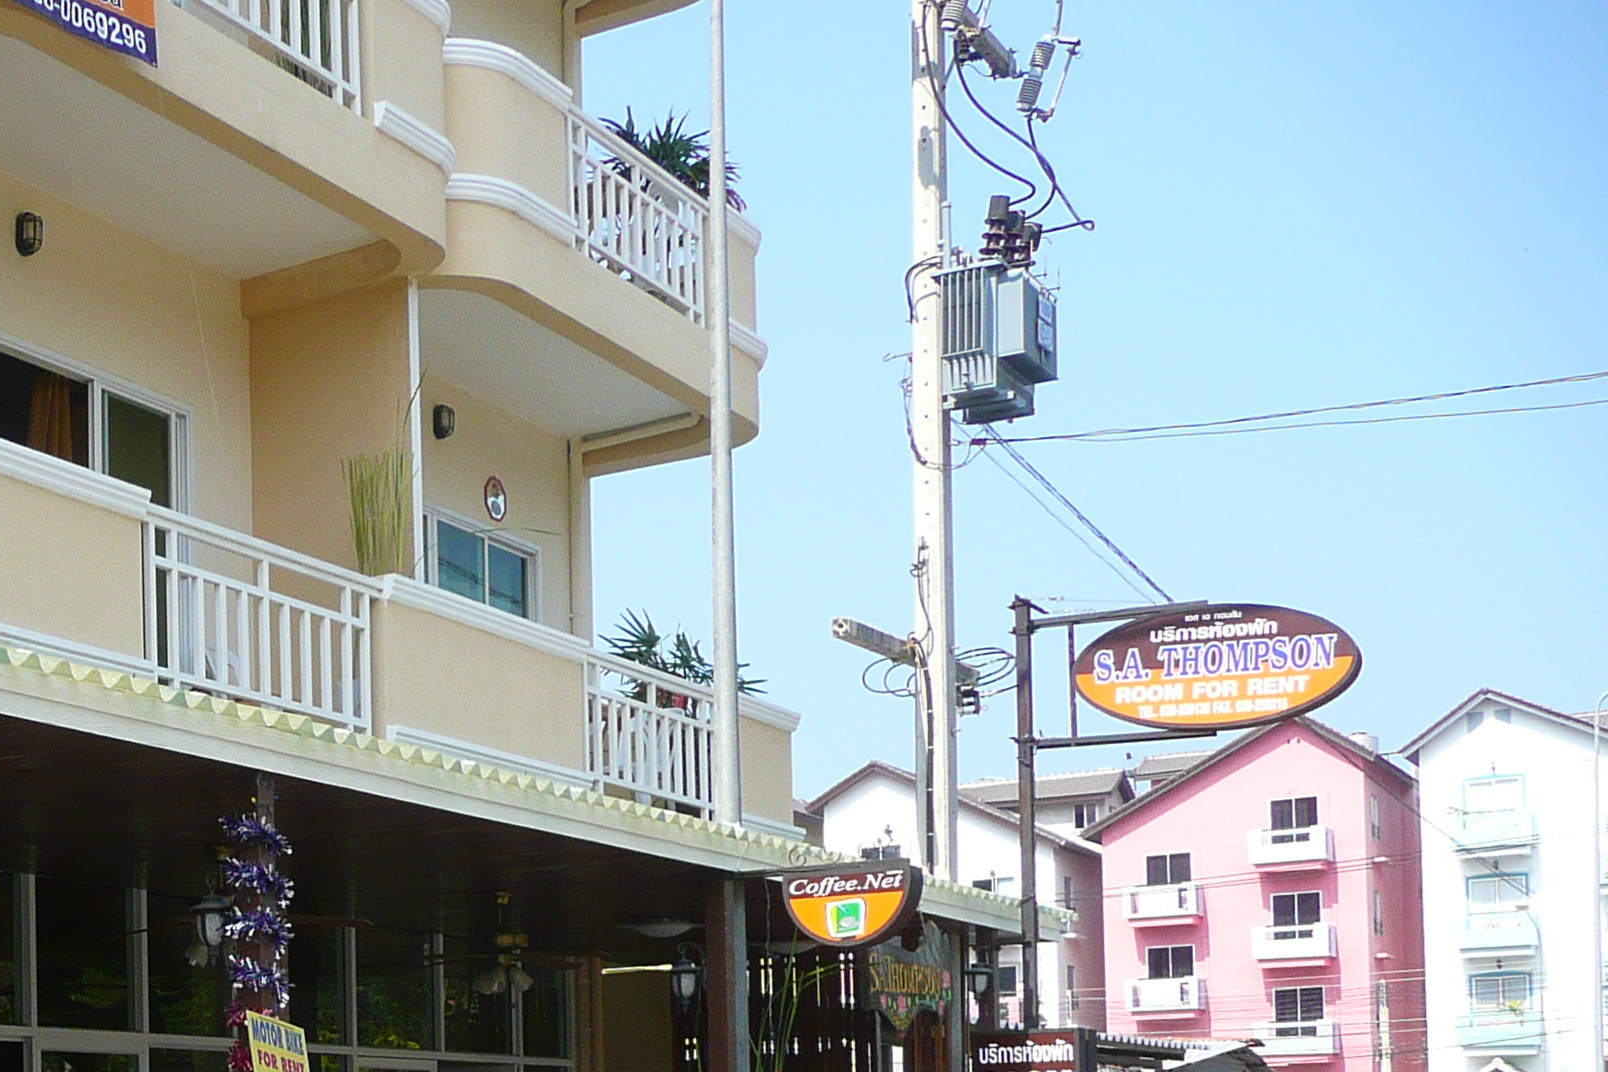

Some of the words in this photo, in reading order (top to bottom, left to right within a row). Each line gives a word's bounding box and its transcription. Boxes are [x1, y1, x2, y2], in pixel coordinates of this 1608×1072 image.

[34, 0, 147, 54] -0069296
[1094, 648, 1152, 684] S.A.
[1157, 633, 1338, 680] THOMPSON
[1115, 683, 1184, 704] ROOM
[1192, 680, 1239, 700] FOR
[1247, 675, 1310, 696] RENT
[788, 869, 904, 897] Coffee.Net
[251, 1018, 285, 1049] MOTOR
[285, 1029, 305, 1056] BIKE
[979, 1039, 1074, 1064] บริการห้องพัก
[257, 1050, 278, 1070] FOR
